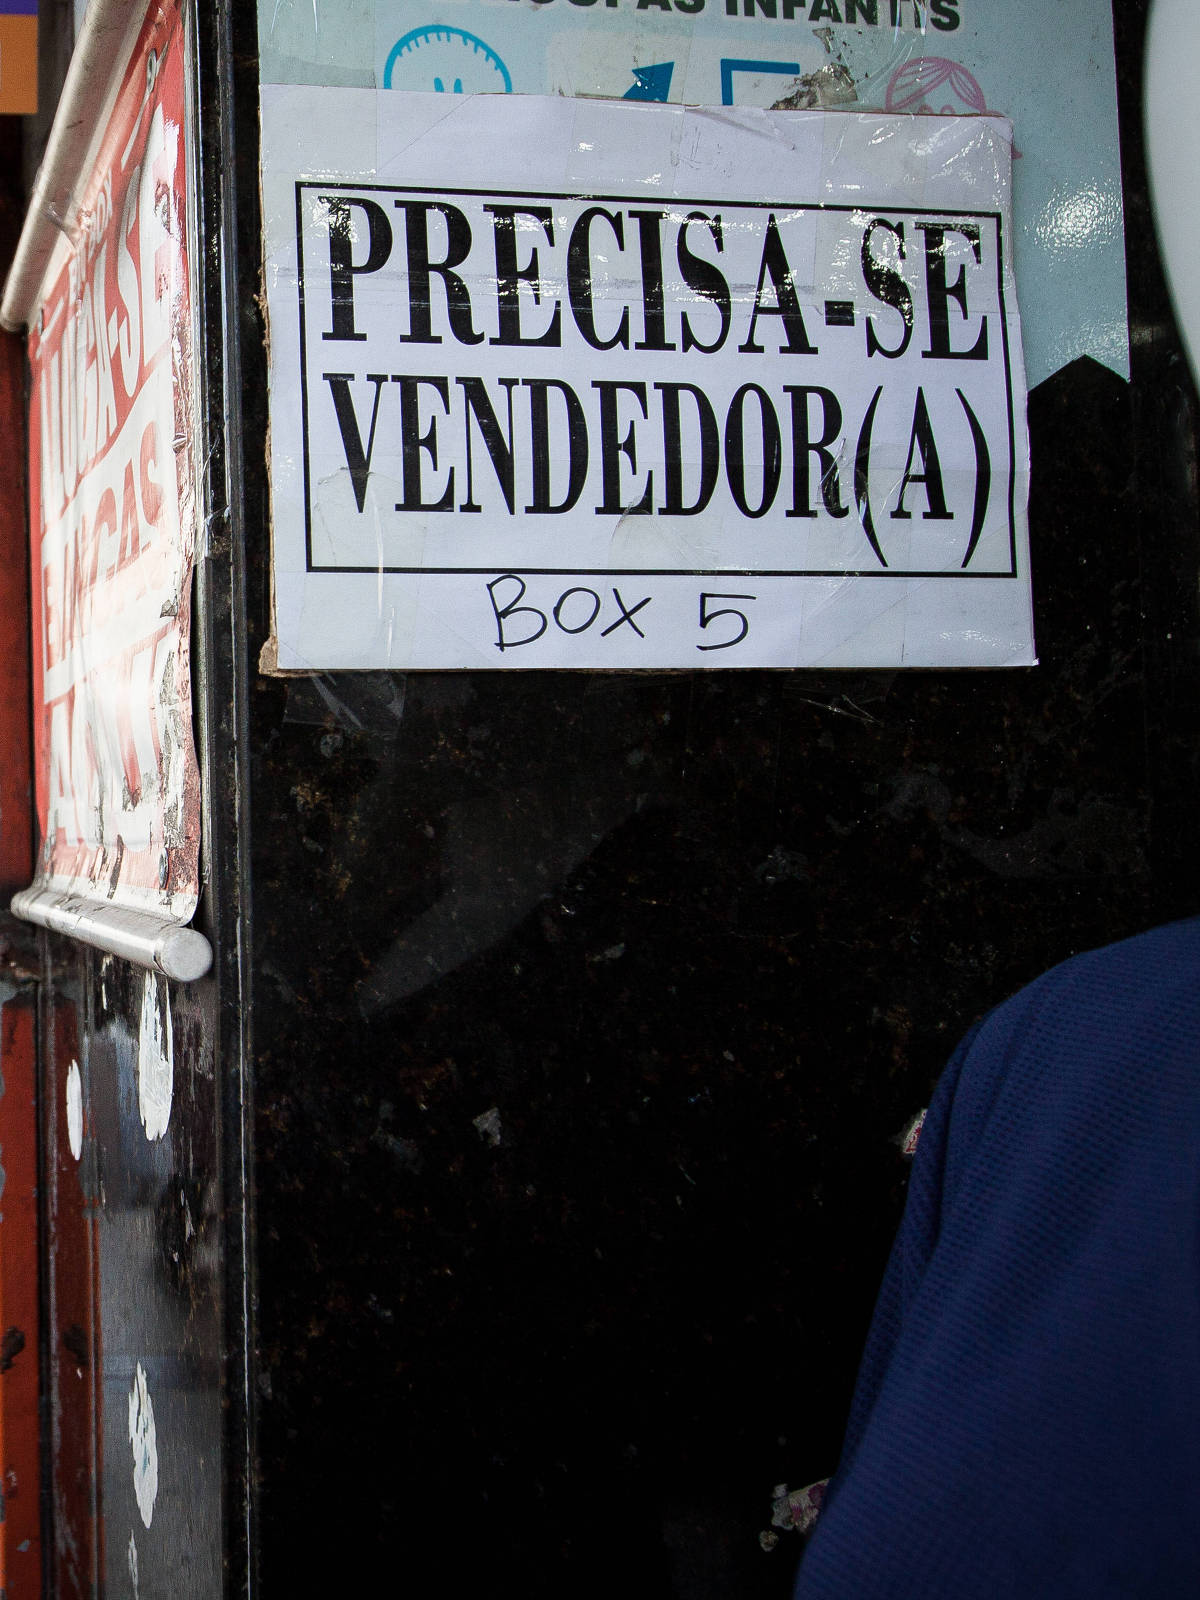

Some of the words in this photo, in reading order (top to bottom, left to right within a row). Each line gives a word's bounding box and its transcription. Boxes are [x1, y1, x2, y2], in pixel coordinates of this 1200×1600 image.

[317, 195, 988, 361] PRECISA-SE
[323, 373, 991, 568] VENDEDOR(A)
[488, 575, 652, 651] BOX
[697, 593, 757, 651] 5
